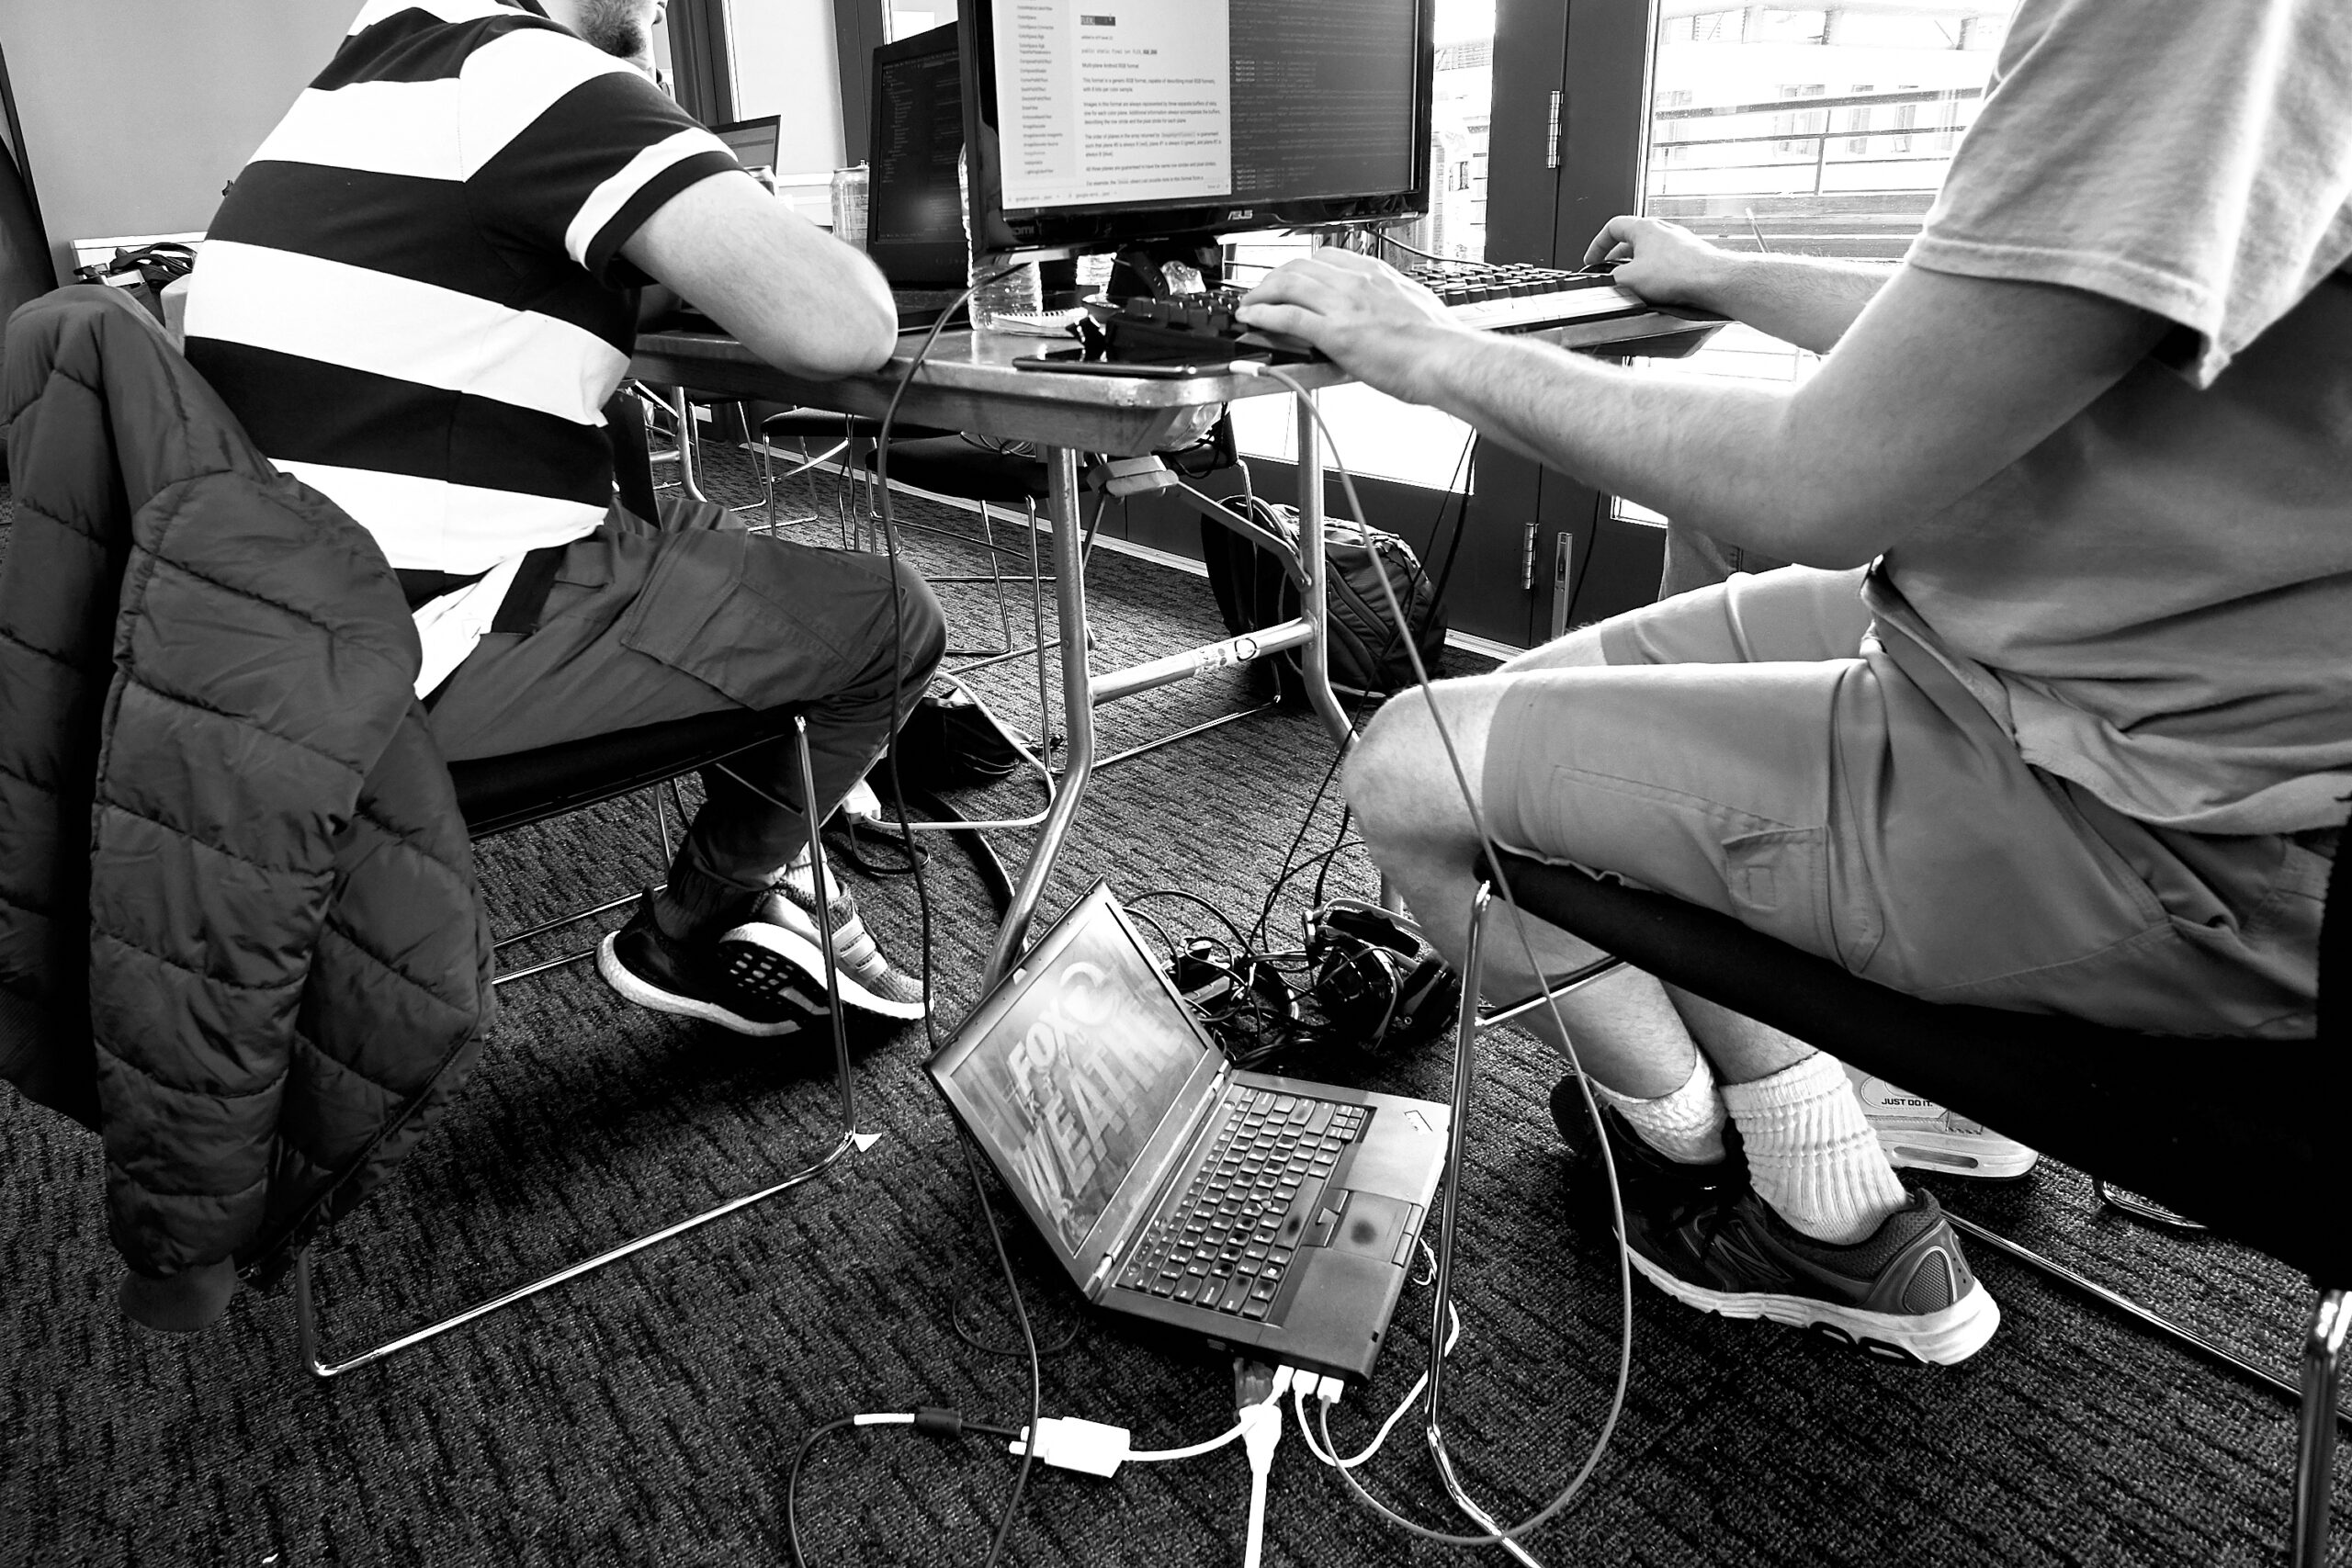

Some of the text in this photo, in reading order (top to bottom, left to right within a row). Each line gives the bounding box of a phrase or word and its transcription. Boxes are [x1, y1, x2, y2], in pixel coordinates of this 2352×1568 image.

[1227, 209, 1253, 220] ASUS
[1007, 998, 1079, 1098] FOX
[1882, 1098, 1906, 1106] JUST
[1907, 1099, 1922, 1107] DO
